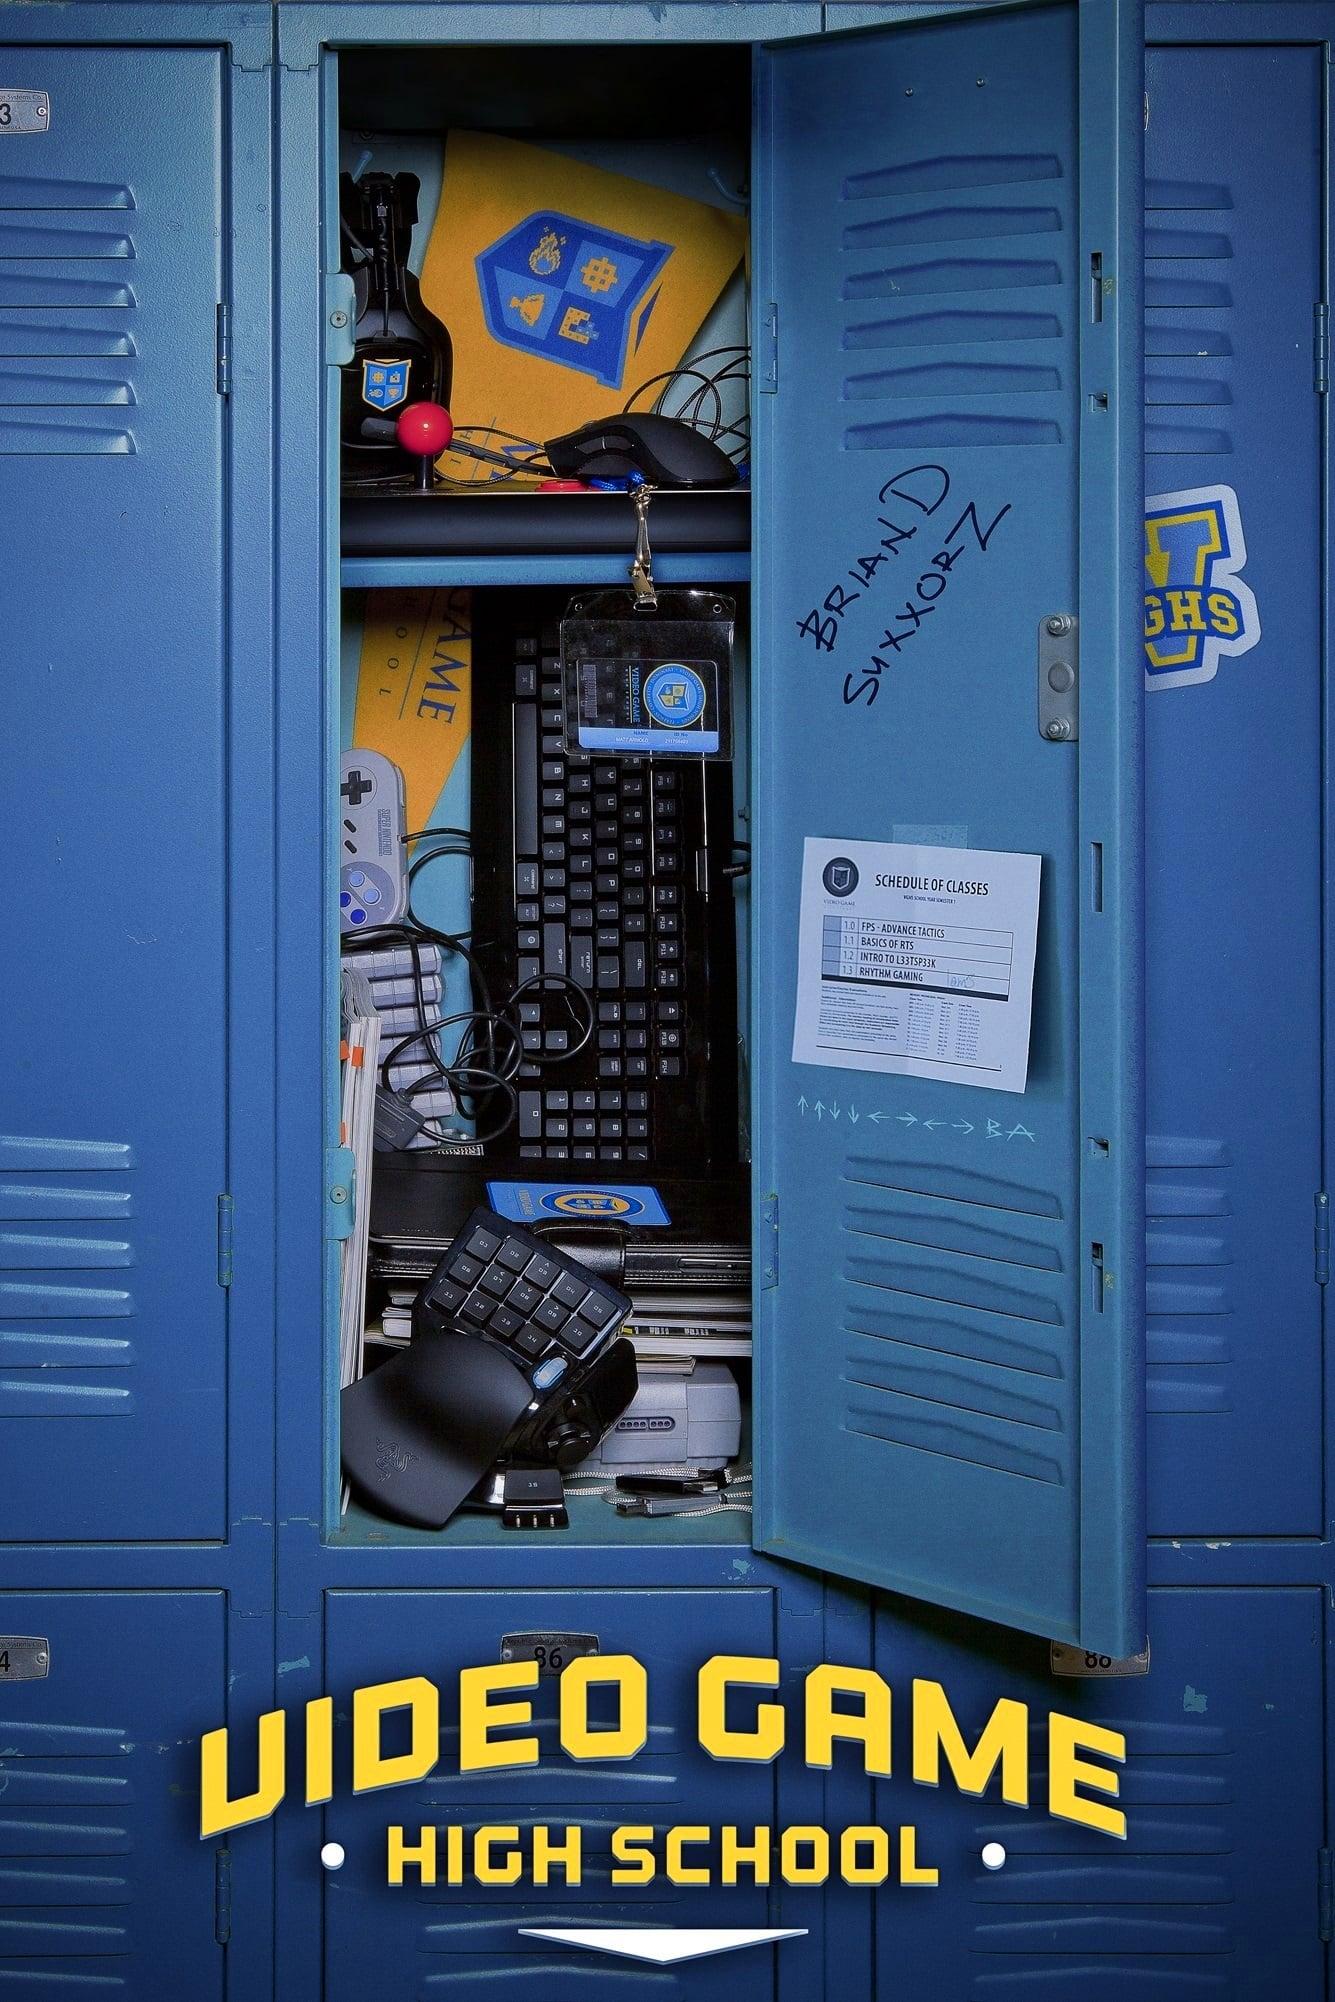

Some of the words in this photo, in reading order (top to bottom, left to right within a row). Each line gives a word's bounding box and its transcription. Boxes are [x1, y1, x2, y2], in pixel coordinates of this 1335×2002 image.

[0, 103, 12, 125] 3
[875, 874, 928, 892] SCHEDULE
[931, 878, 944, 892] OF
[946, 880, 989, 896] CLASSES
[844, 918, 855, 930] 1.0
[861, 921, 876, 932] FPS
[881, 923, 917, 935] ADVANCE
[918, 926, 945, 938] TACTICS
[844, 936, 854, 945] 1.1
[861, 937, 887, 948] BASICS
[889, 940, 898, 949] OF
[900, 941, 914, 950] RTS
[843, 950, 854, 959] 1.2
[860, 952, 883, 962] INTRO
[885, 954, 894, 963] TO
[896, 955, 936, 968] L33TSP33K
[842, 965, 853, 975] 1.3
[860, 967, 891, 979] RHYTHM
[893, 970, 923, 981] GAMING
[0, 1650, 10, 1672] 4
[534, 1646, 562, 1668] 86
